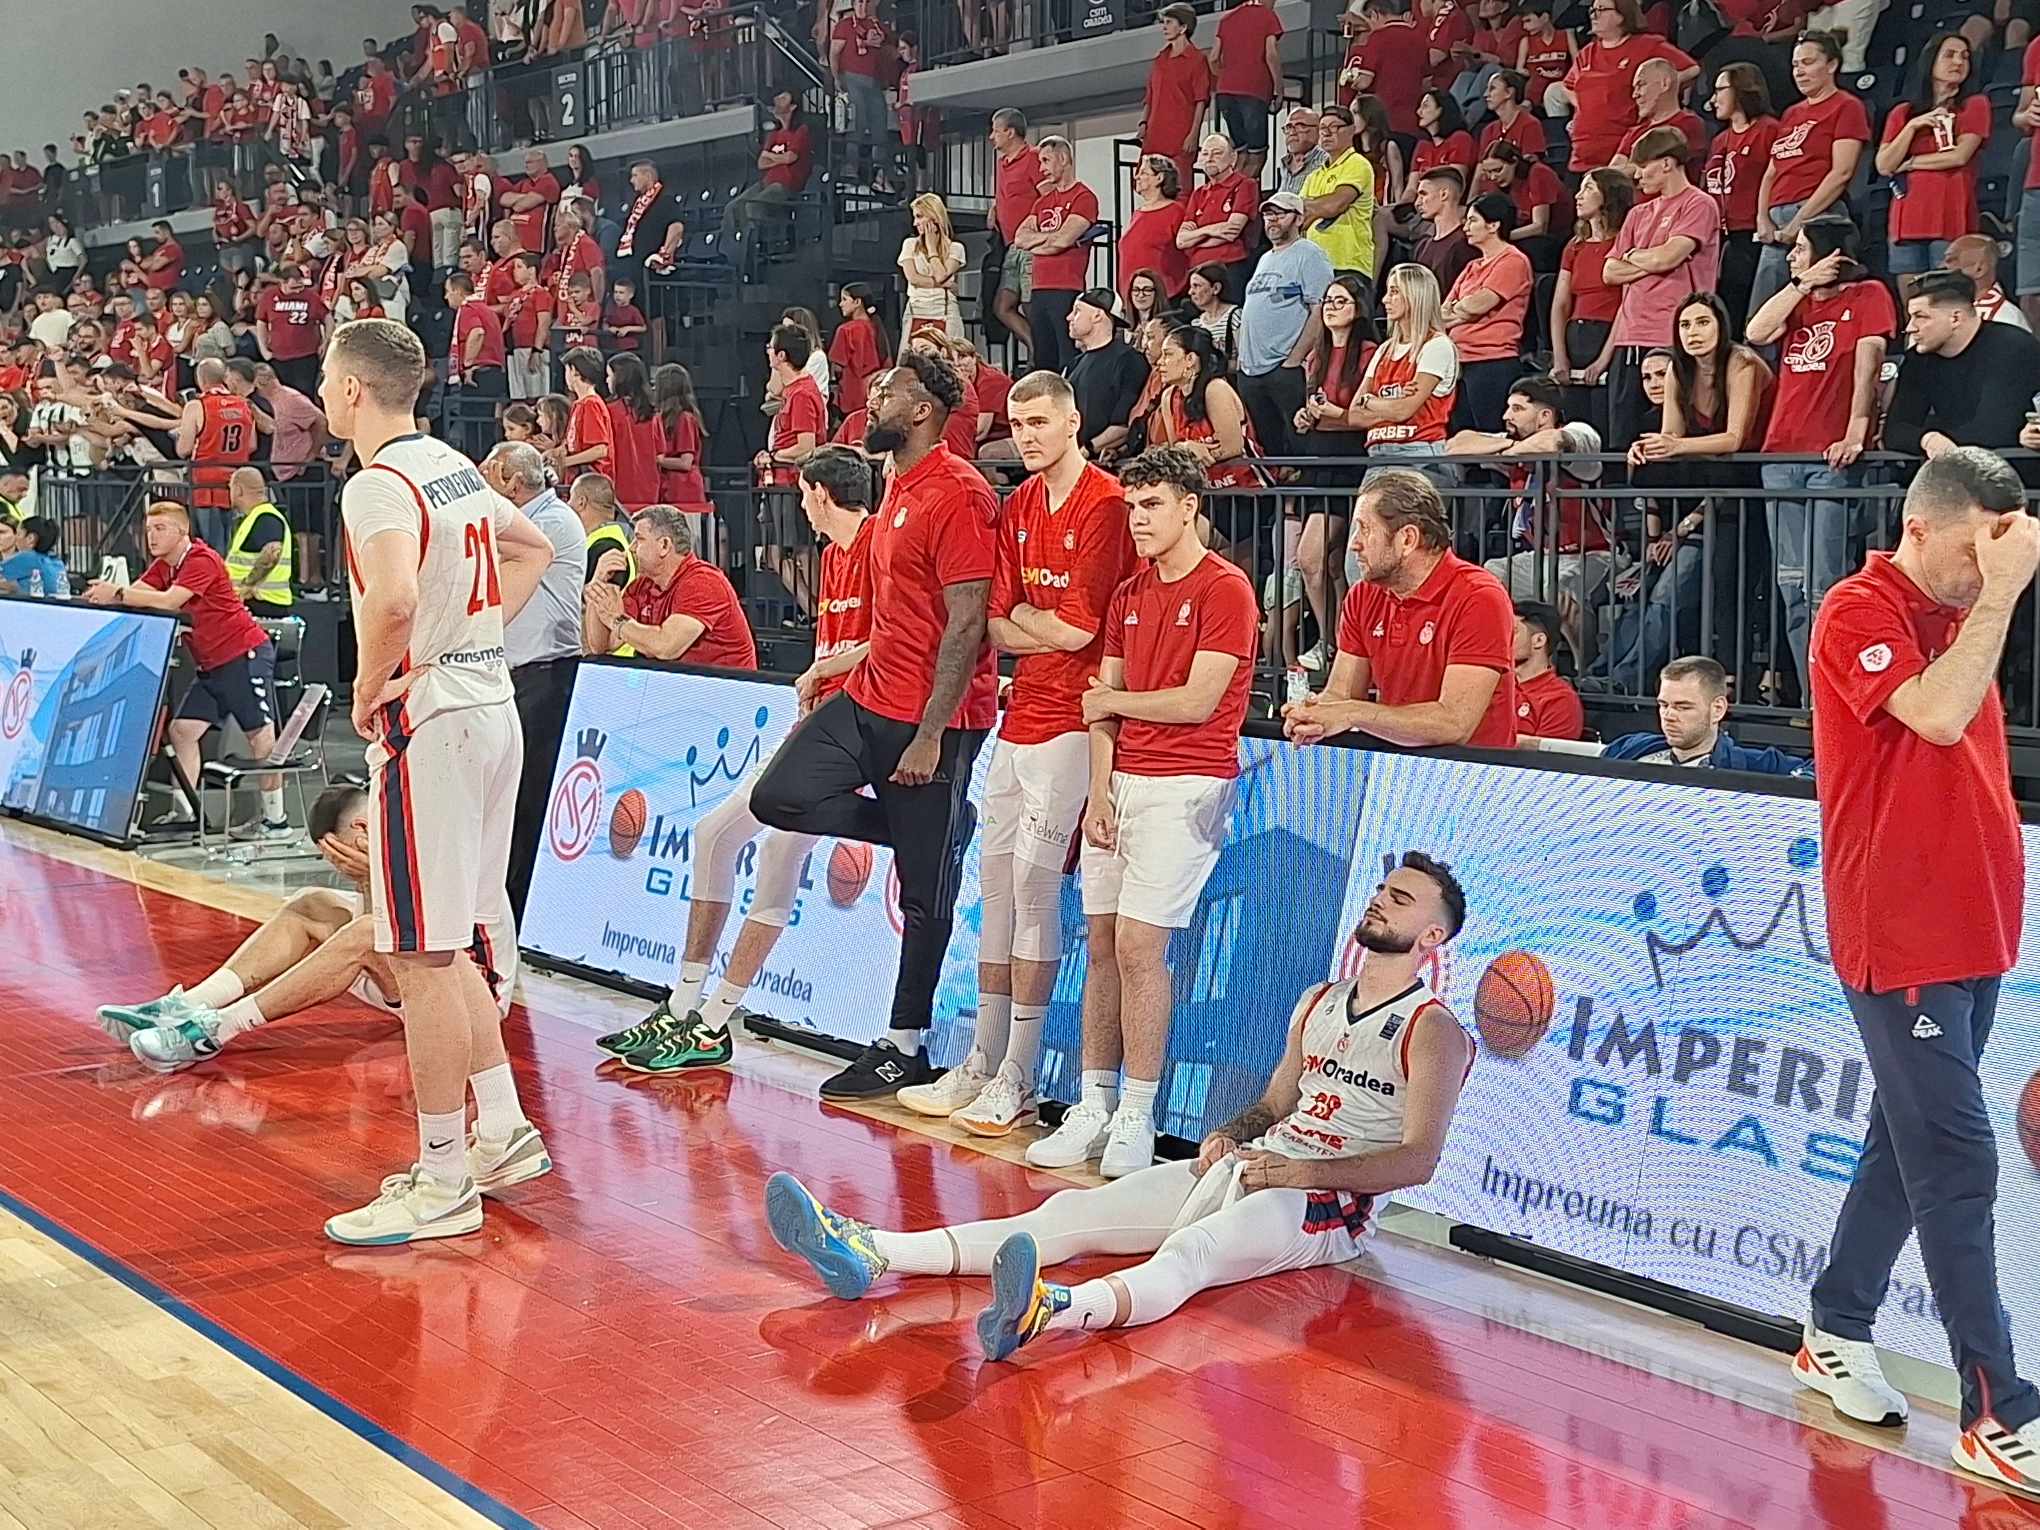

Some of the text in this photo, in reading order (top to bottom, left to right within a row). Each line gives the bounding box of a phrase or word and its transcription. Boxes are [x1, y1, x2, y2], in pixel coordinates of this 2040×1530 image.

[561, 93, 574, 126] 2
[152, 182, 160, 208] 1
[274, 301, 309, 312] MIAMI
[289, 311, 309, 325] 22
[222, 424, 243, 454] 13
[1367, 424, 1418, 440] ERBET
[465, 516, 502, 616] 21
[649, 815, 814, 891] IMRL
[601, 920, 676, 965] Impreuna
[1911, 1025, 1944, 1038] PEAK
[1568, 995, 1864, 1121] IMPERI
[1568, 1076, 1864, 1185] GLAS
[1479, 1154, 1830, 1284] Impreuna cu CSM
